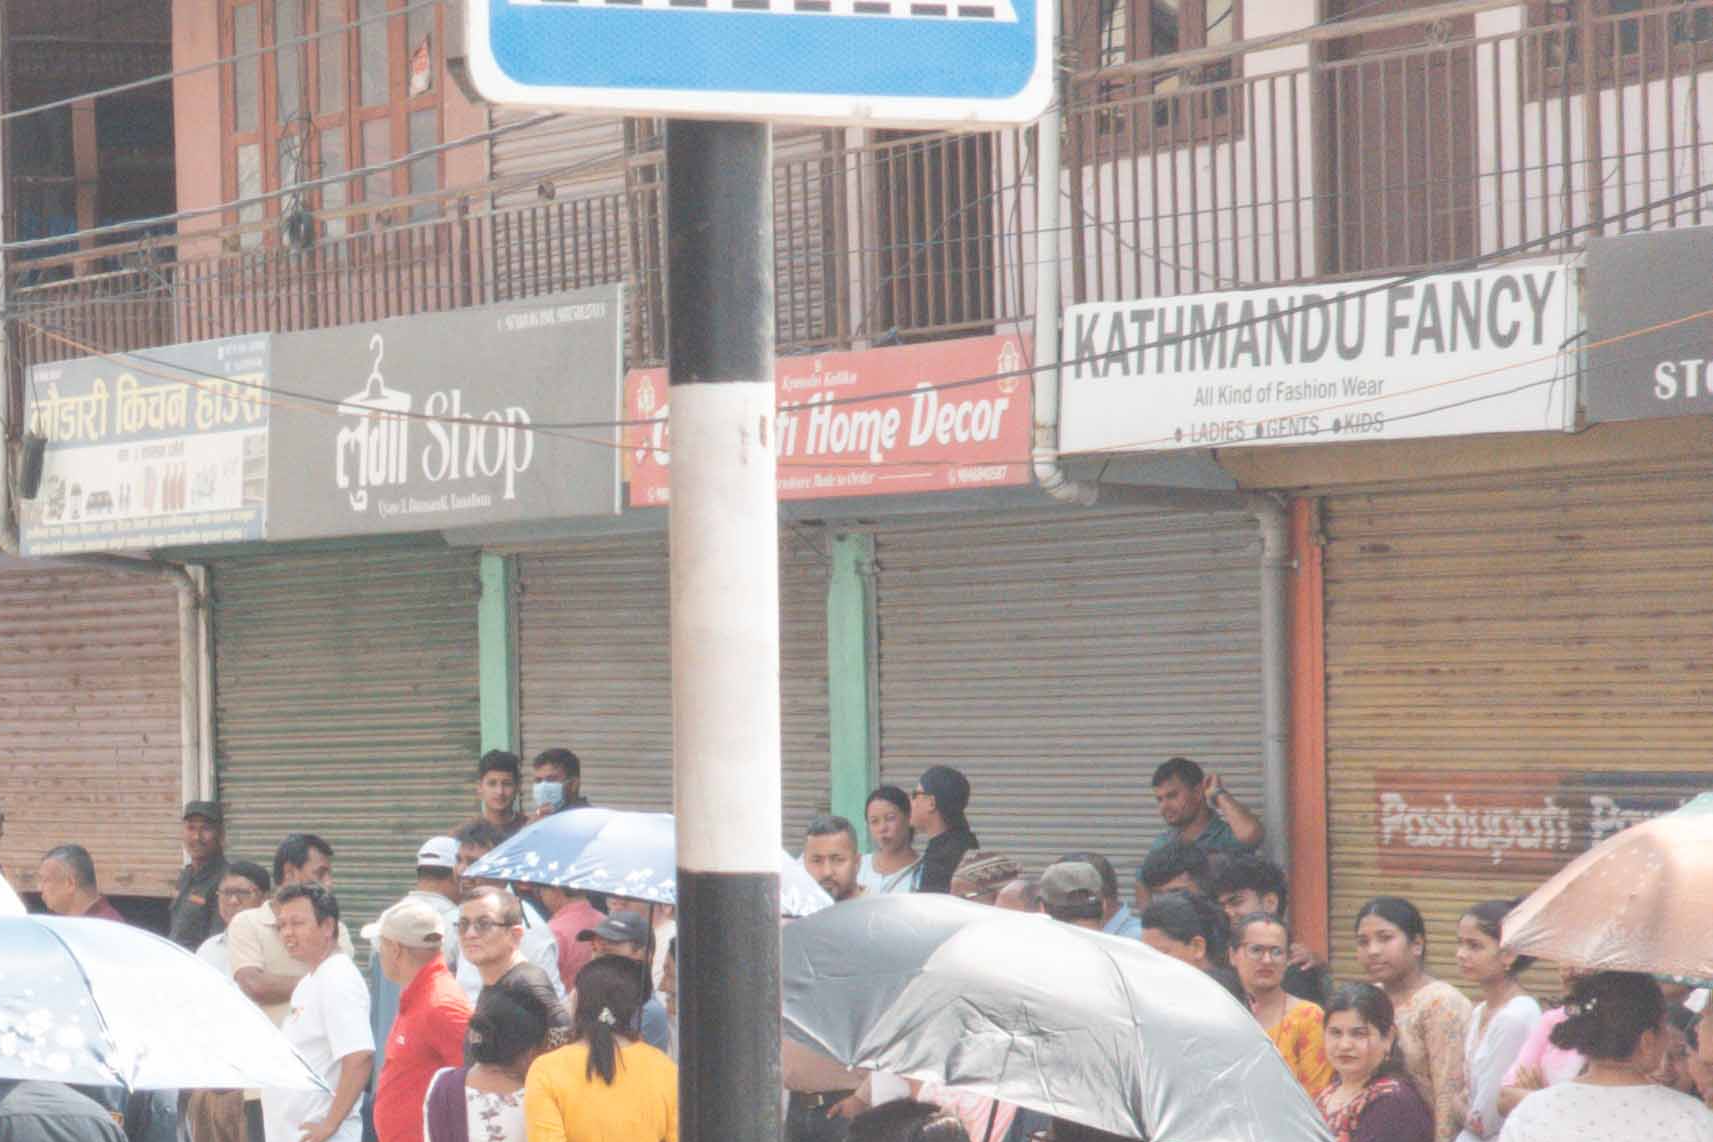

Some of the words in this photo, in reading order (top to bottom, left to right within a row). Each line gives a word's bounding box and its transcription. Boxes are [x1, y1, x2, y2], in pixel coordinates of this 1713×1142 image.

[1073, 292, 1367, 380] KATHMANDU
[1384, 270, 1557, 359] FANCY
[806, 390, 897, 463] Home
[908, 381, 1011, 447] Decor
[1190, 418, 1246, 443] LADIES
[1265, 415, 1321, 438] GENTS
[1343, 411, 1386, 433] KIDS
[1192, 385, 1213, 408] All
[1217, 384, 1253, 406] Kind
[1256, 382, 1273, 404] of
[1275, 378, 1337, 402] Fashion
[1341, 375, 1385, 398] Wear
[421, 389, 535, 500] Shop
